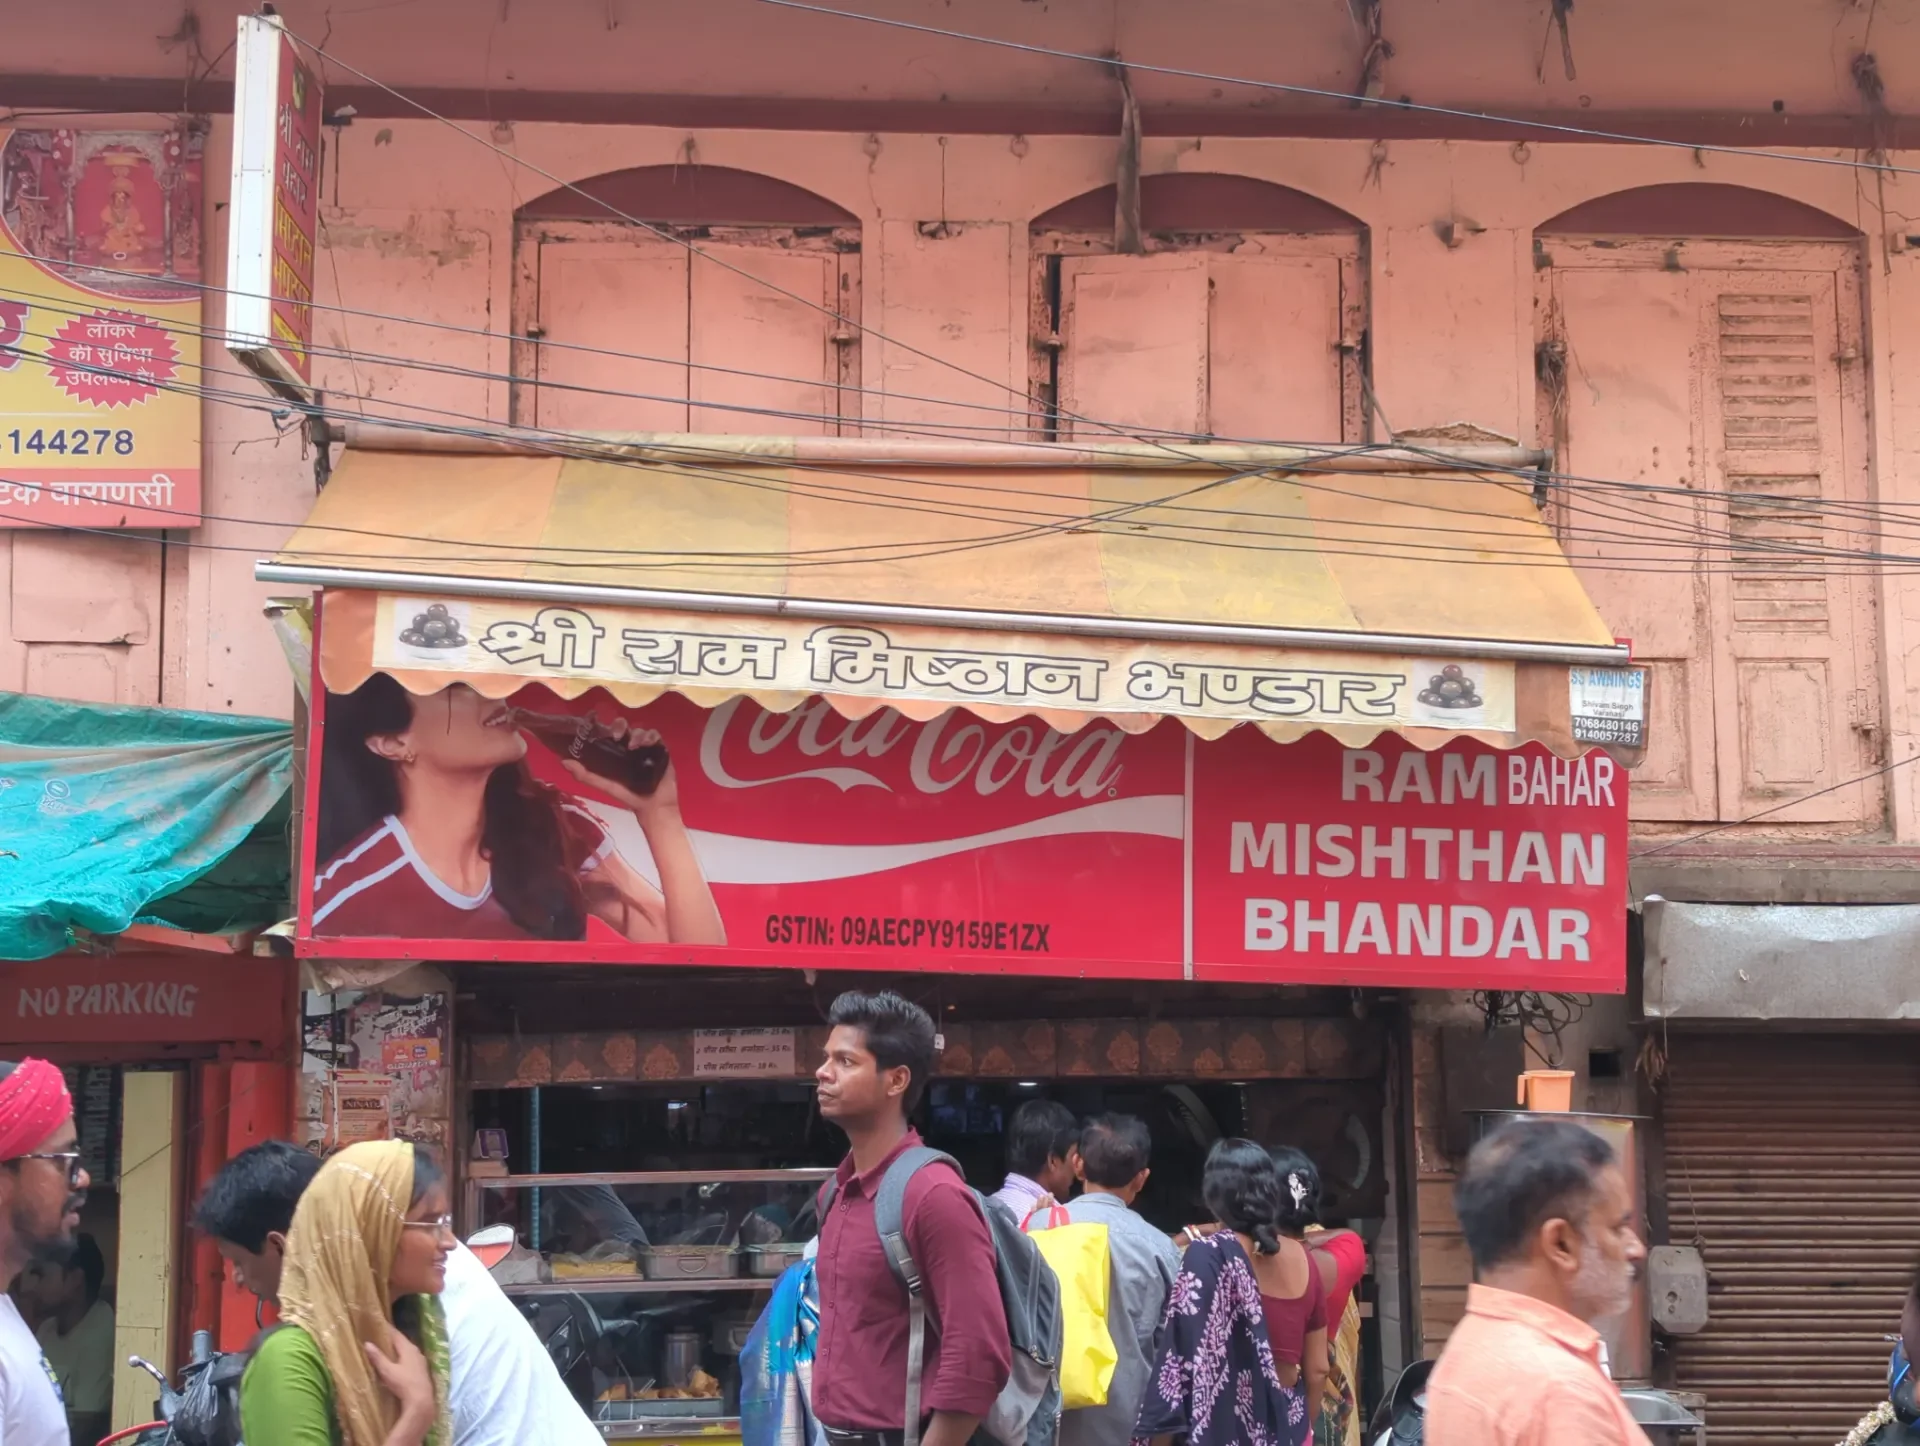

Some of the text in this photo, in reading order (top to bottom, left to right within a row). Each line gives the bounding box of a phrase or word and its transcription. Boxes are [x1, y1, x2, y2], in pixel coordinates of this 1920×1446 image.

[97, 342, 154, 367] सुविधा
[0, 428, 134, 455] 144278
[50, 473, 176, 506] वाराणसी
[479, 607, 1406, 716] श्री राम मिष्ठान भण्डार
[1588, 668, 1642, 689] AWNINGS
[1574, 717, 1639, 732] 7068480146
[1574, 728, 1639, 744] 9140057287
[1342, 749, 1616, 807] RAM BAHAR
[1229, 821, 1606, 886] MISHTHAN
[765, 914, 1050, 953] GSTIN: 09AECPY9159E1ZX
[1244, 898, 1591, 962] BHANDAR
[18, 981, 199, 1018] NO PARKING
